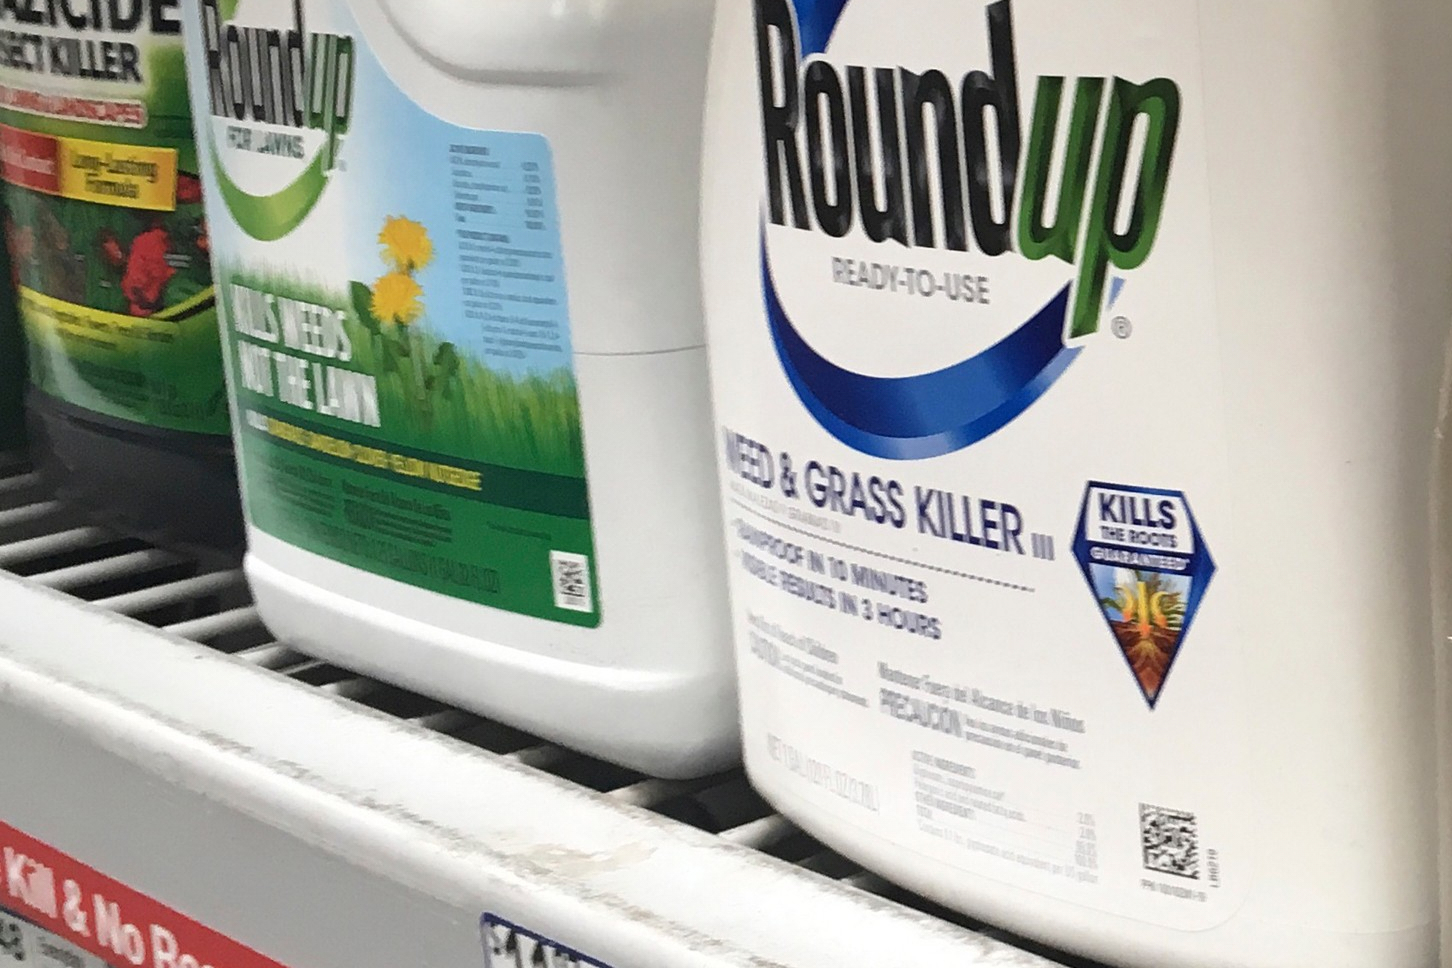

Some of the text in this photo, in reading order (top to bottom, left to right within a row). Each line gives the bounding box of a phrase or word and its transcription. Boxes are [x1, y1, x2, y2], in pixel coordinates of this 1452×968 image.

[50, 36, 143, 82] KILLER
[831, 255, 990, 305] READY-TO-USE
[780, 451, 798, 499] &
[805, 460, 907, 529] GRASS
[914, 485, 1026, 555] KILLER
[1099, 491, 1178, 548] KILLS THE ROOTS
[807, 549, 825, 574] IN
[827, 556, 849, 581] 10
[838, 591, 859, 616] IN
[861, 597, 874, 621] 3
[876, 602, 942, 640] HOURS
[63, 879, 91, 937] &
[93, 893, 146, 966] No
